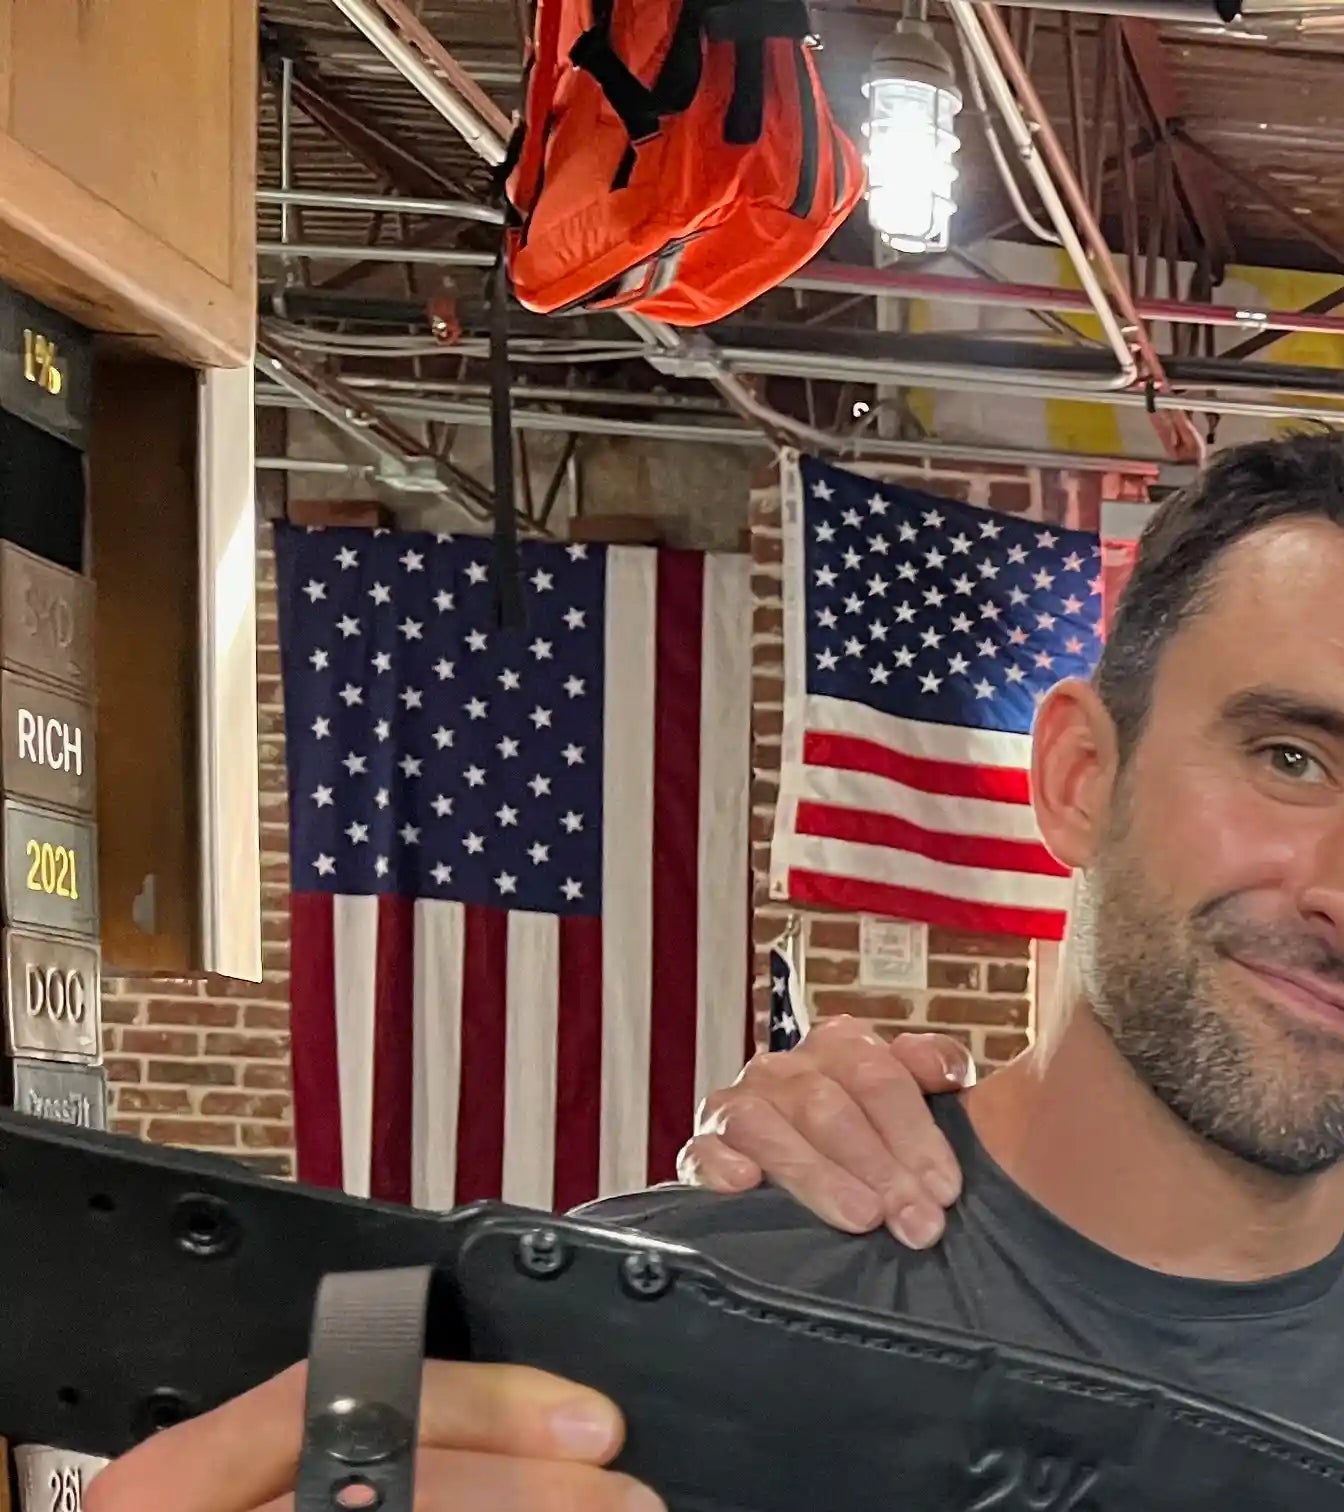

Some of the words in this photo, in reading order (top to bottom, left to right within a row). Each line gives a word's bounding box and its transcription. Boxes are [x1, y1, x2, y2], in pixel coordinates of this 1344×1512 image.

[23, 329, 62, 394] 1%
[18, 708, 82, 776] RICH
[26, 839, 79, 899] 2021
[26, 962, 85, 1024] DOC
